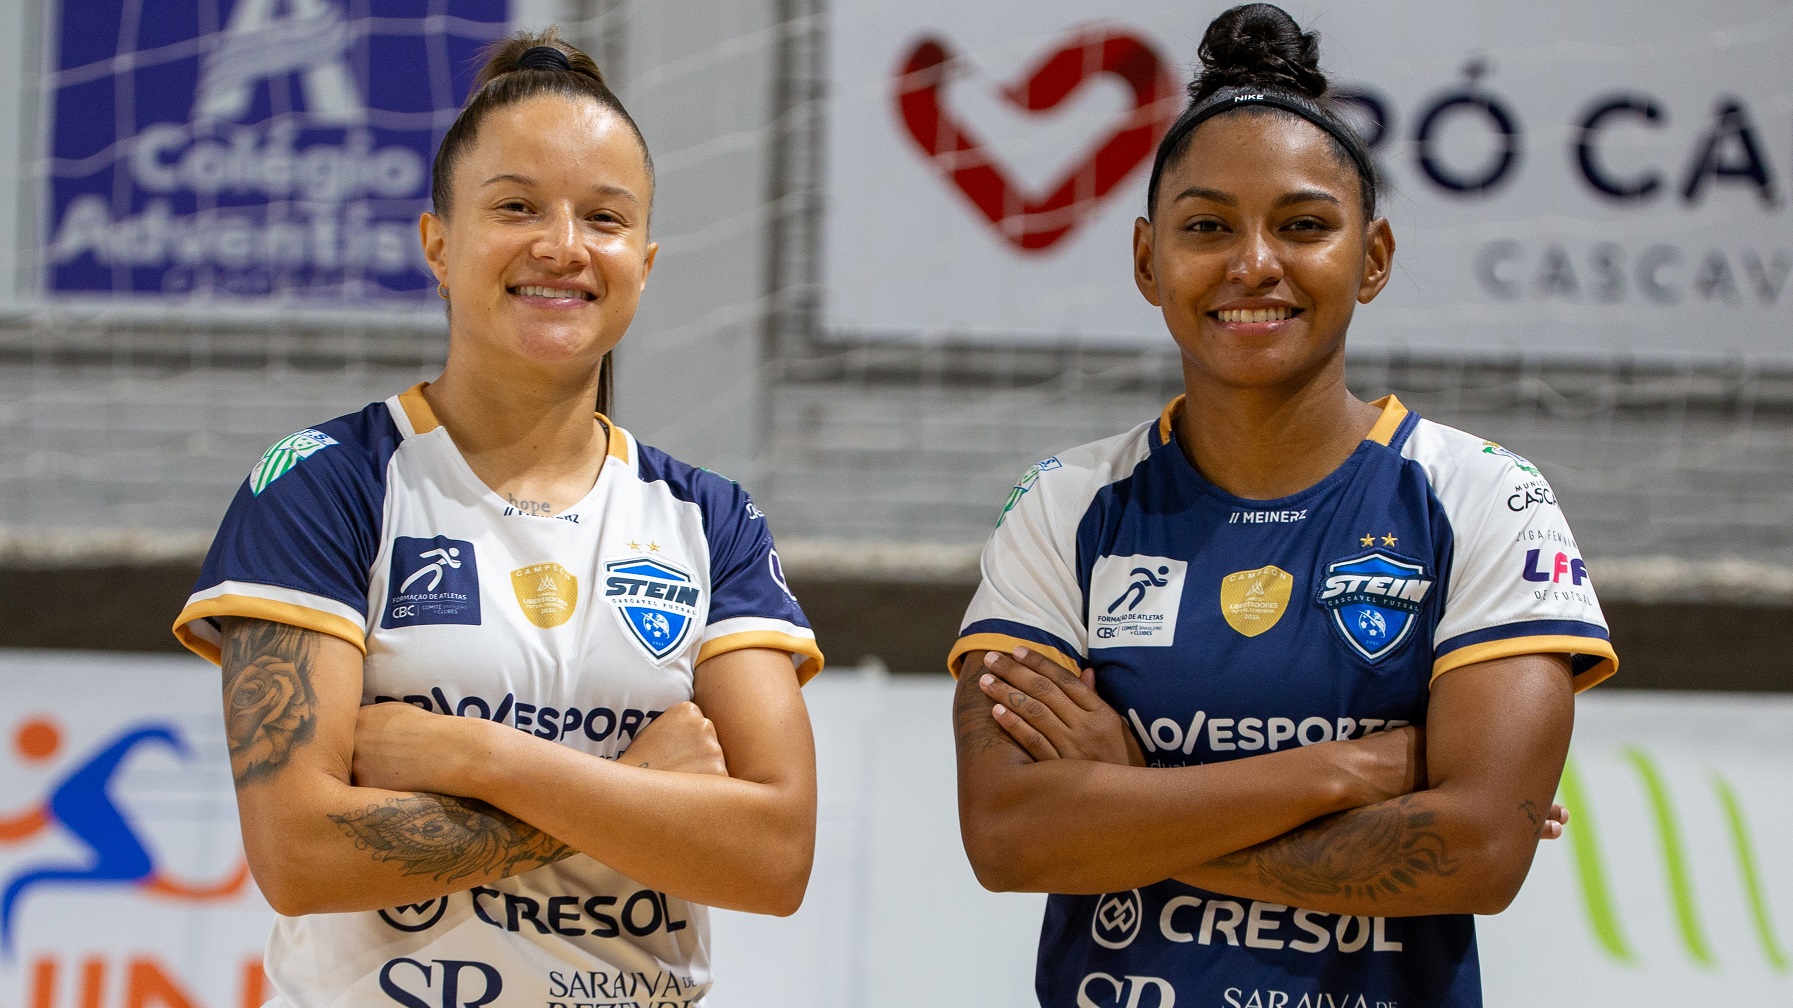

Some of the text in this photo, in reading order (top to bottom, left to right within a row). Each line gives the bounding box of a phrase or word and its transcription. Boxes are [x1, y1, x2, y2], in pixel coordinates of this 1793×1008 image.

[1234, 94, 1264, 103] NIKE
[1575, 89, 1778, 206] CA
[131, 120, 424, 205] Colégio
[508, 493, 551, 516] hope
[1243, 509, 1308, 524] MEINERZ
[1522, 548, 1588, 586] LFF
[392, 593, 428, 604] FORMAÇÃO
[439, 592, 467, 600] ATLETAS
[605, 576, 700, 608] STEIN
[1321, 574, 1432, 604] STEIN
[1534, 589, 1593, 606] DE FUTSAL
[392, 604, 415, 619] CBC
[1229, 601, 1279, 610] LIBERTADORES
[1328, 595, 1419, 612] CASCAVEL FUTSAL
[1096, 627, 1118, 639] CBC
[470, 886, 688, 938] CRESOL
[1159, 895, 1403, 954] CRESOL
[549, 970, 682, 999] SARAIVA
